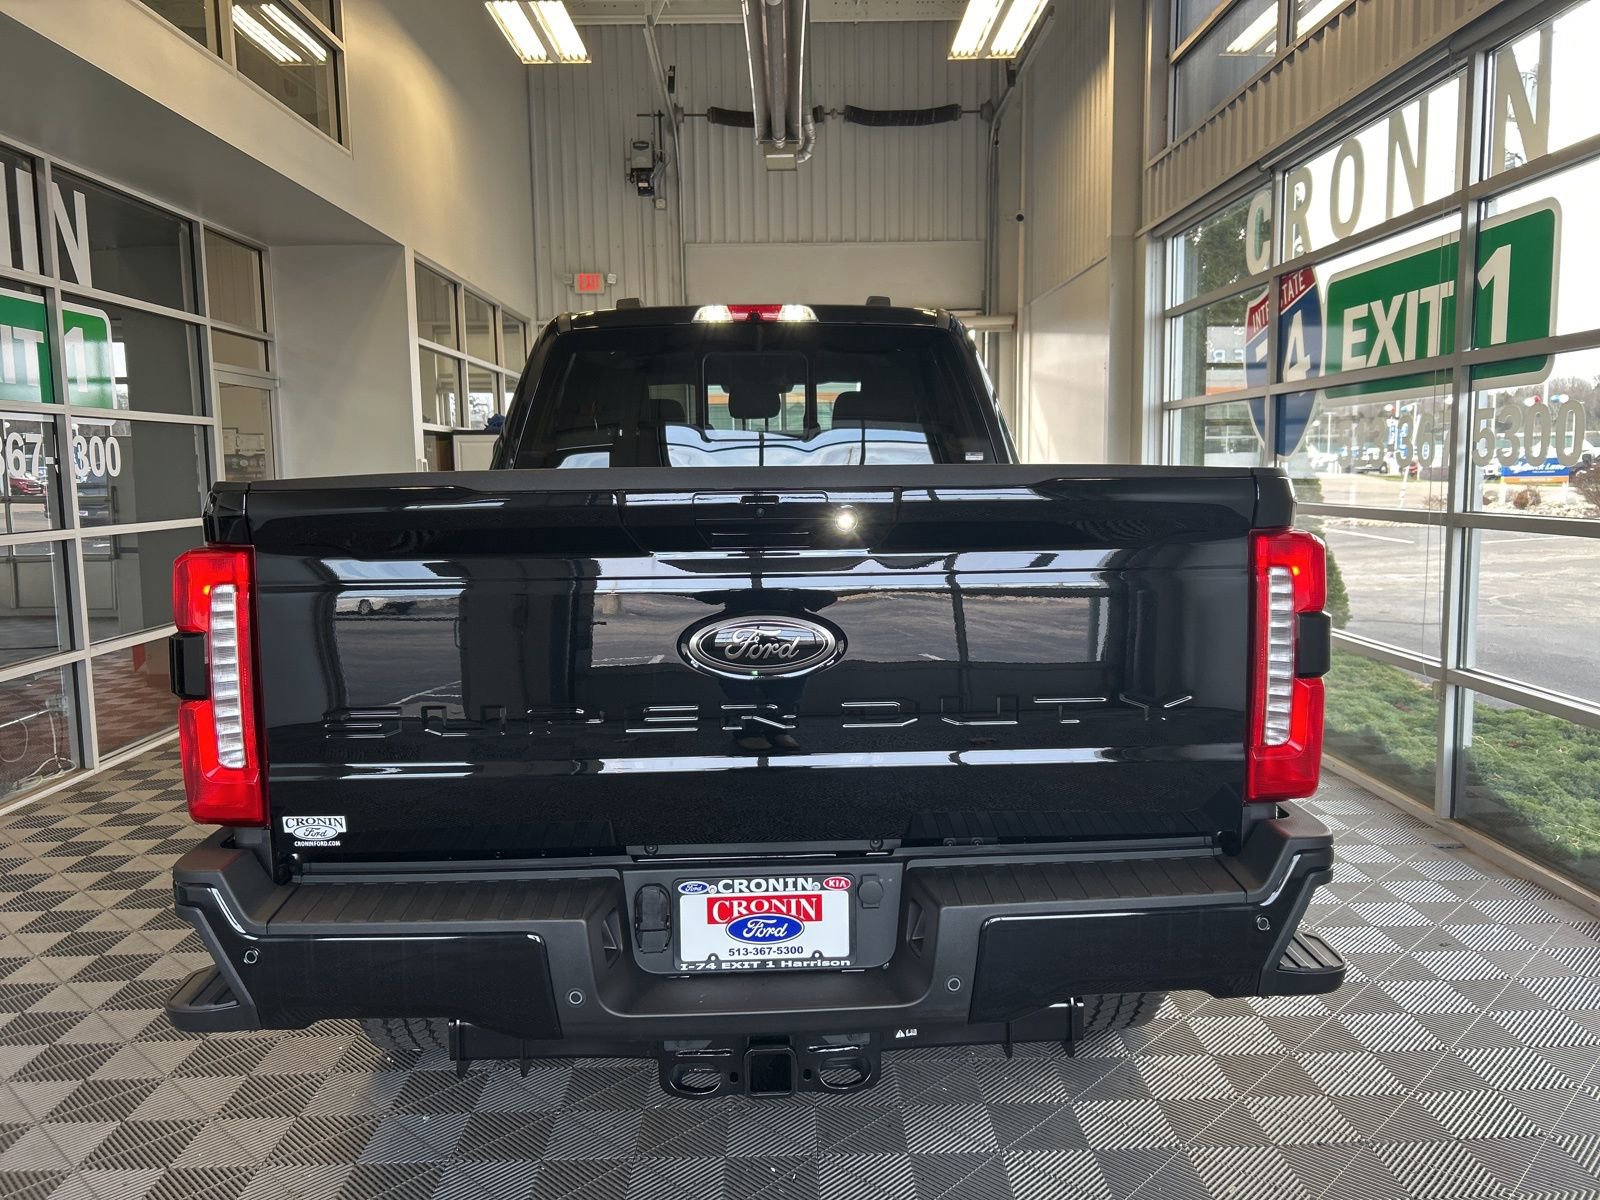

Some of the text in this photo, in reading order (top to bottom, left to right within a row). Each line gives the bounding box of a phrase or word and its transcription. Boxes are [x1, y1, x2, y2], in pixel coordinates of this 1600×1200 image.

[578, 272, 600, 291] EXIT
[1342, 244, 1512, 369] EXIT 1
[64, 326, 88, 393] 1
[724, 628, 800, 660] Ford
[322, 694, 1193, 739] SUPER DUTY
[285, 817, 344, 829] CRONIN
[303, 827, 328, 837] Ford
[684, 878, 847, 894] Ford CRONIN KIA
[712, 897, 818, 923] CRONIN
[742, 918, 789, 938] Ford
[728, 946, 804, 957] 513-367-5300
[680, 959, 851, 971] I-74 EXIT 1 Harrison
